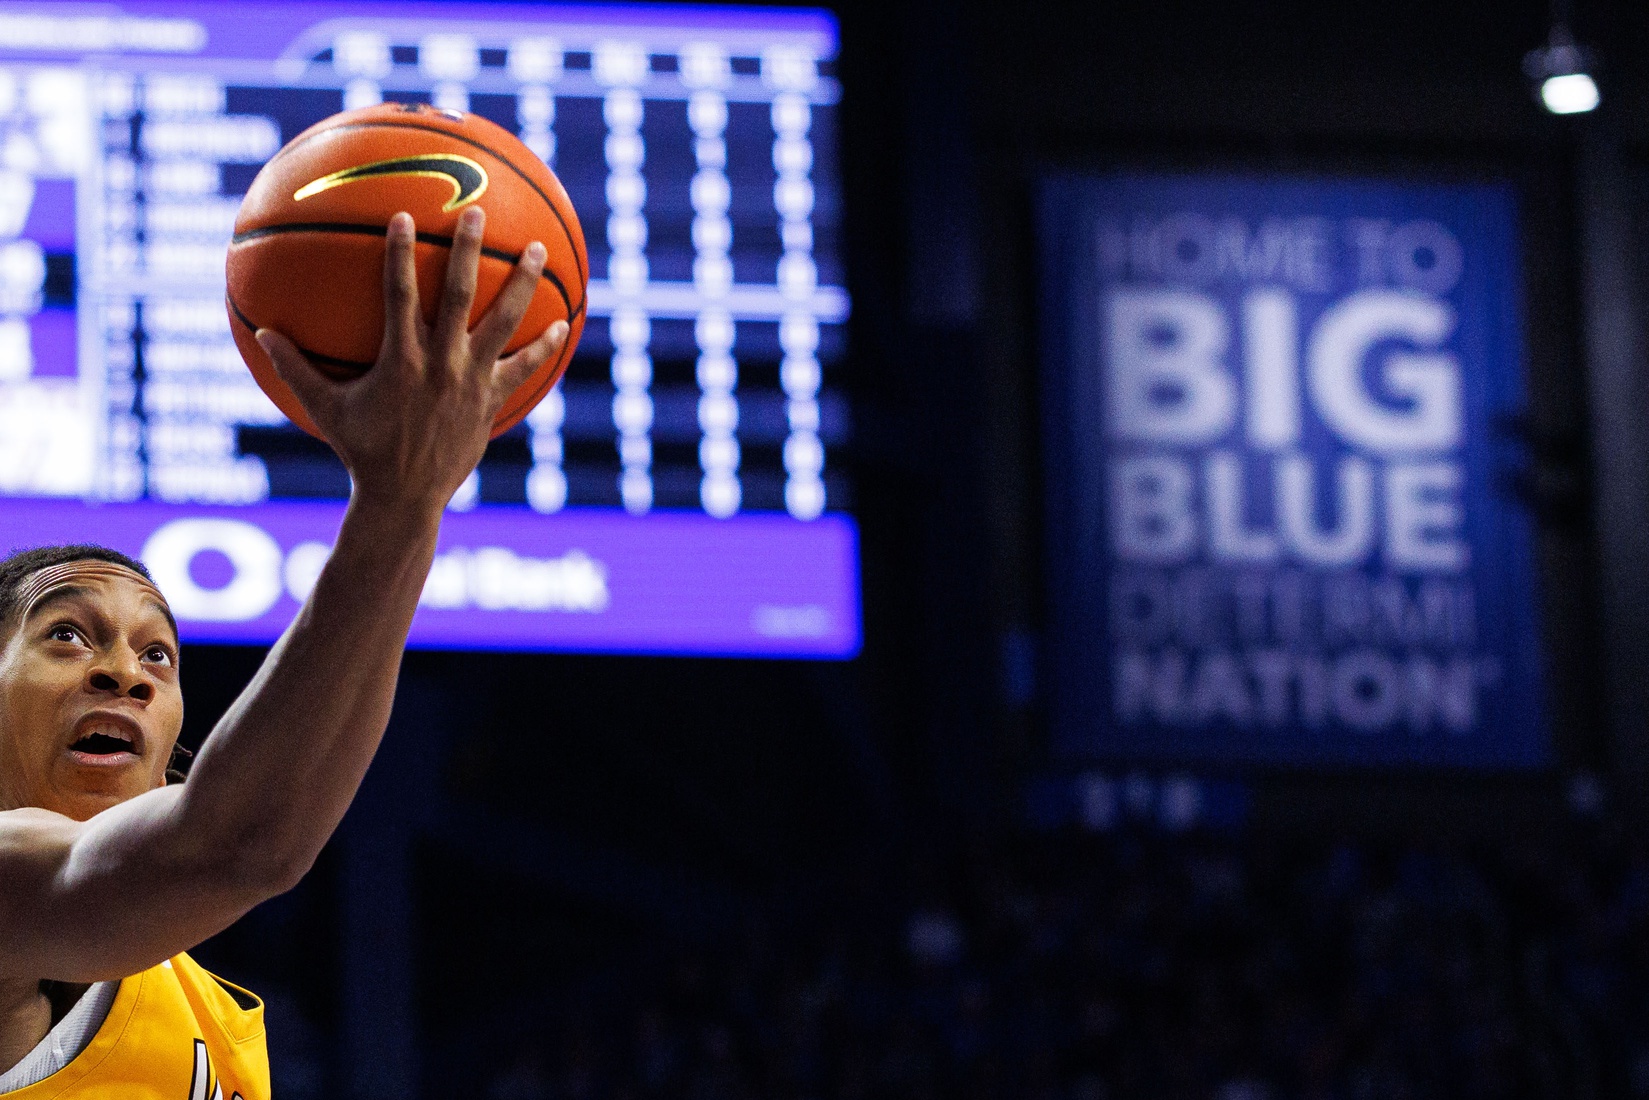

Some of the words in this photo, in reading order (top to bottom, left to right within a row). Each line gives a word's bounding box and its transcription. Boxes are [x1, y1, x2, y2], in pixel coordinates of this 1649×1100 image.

[1346, 218, 1464, 297] TO
[1106, 287, 1463, 454] BIG
[1109, 452, 1468, 571] BLUE
